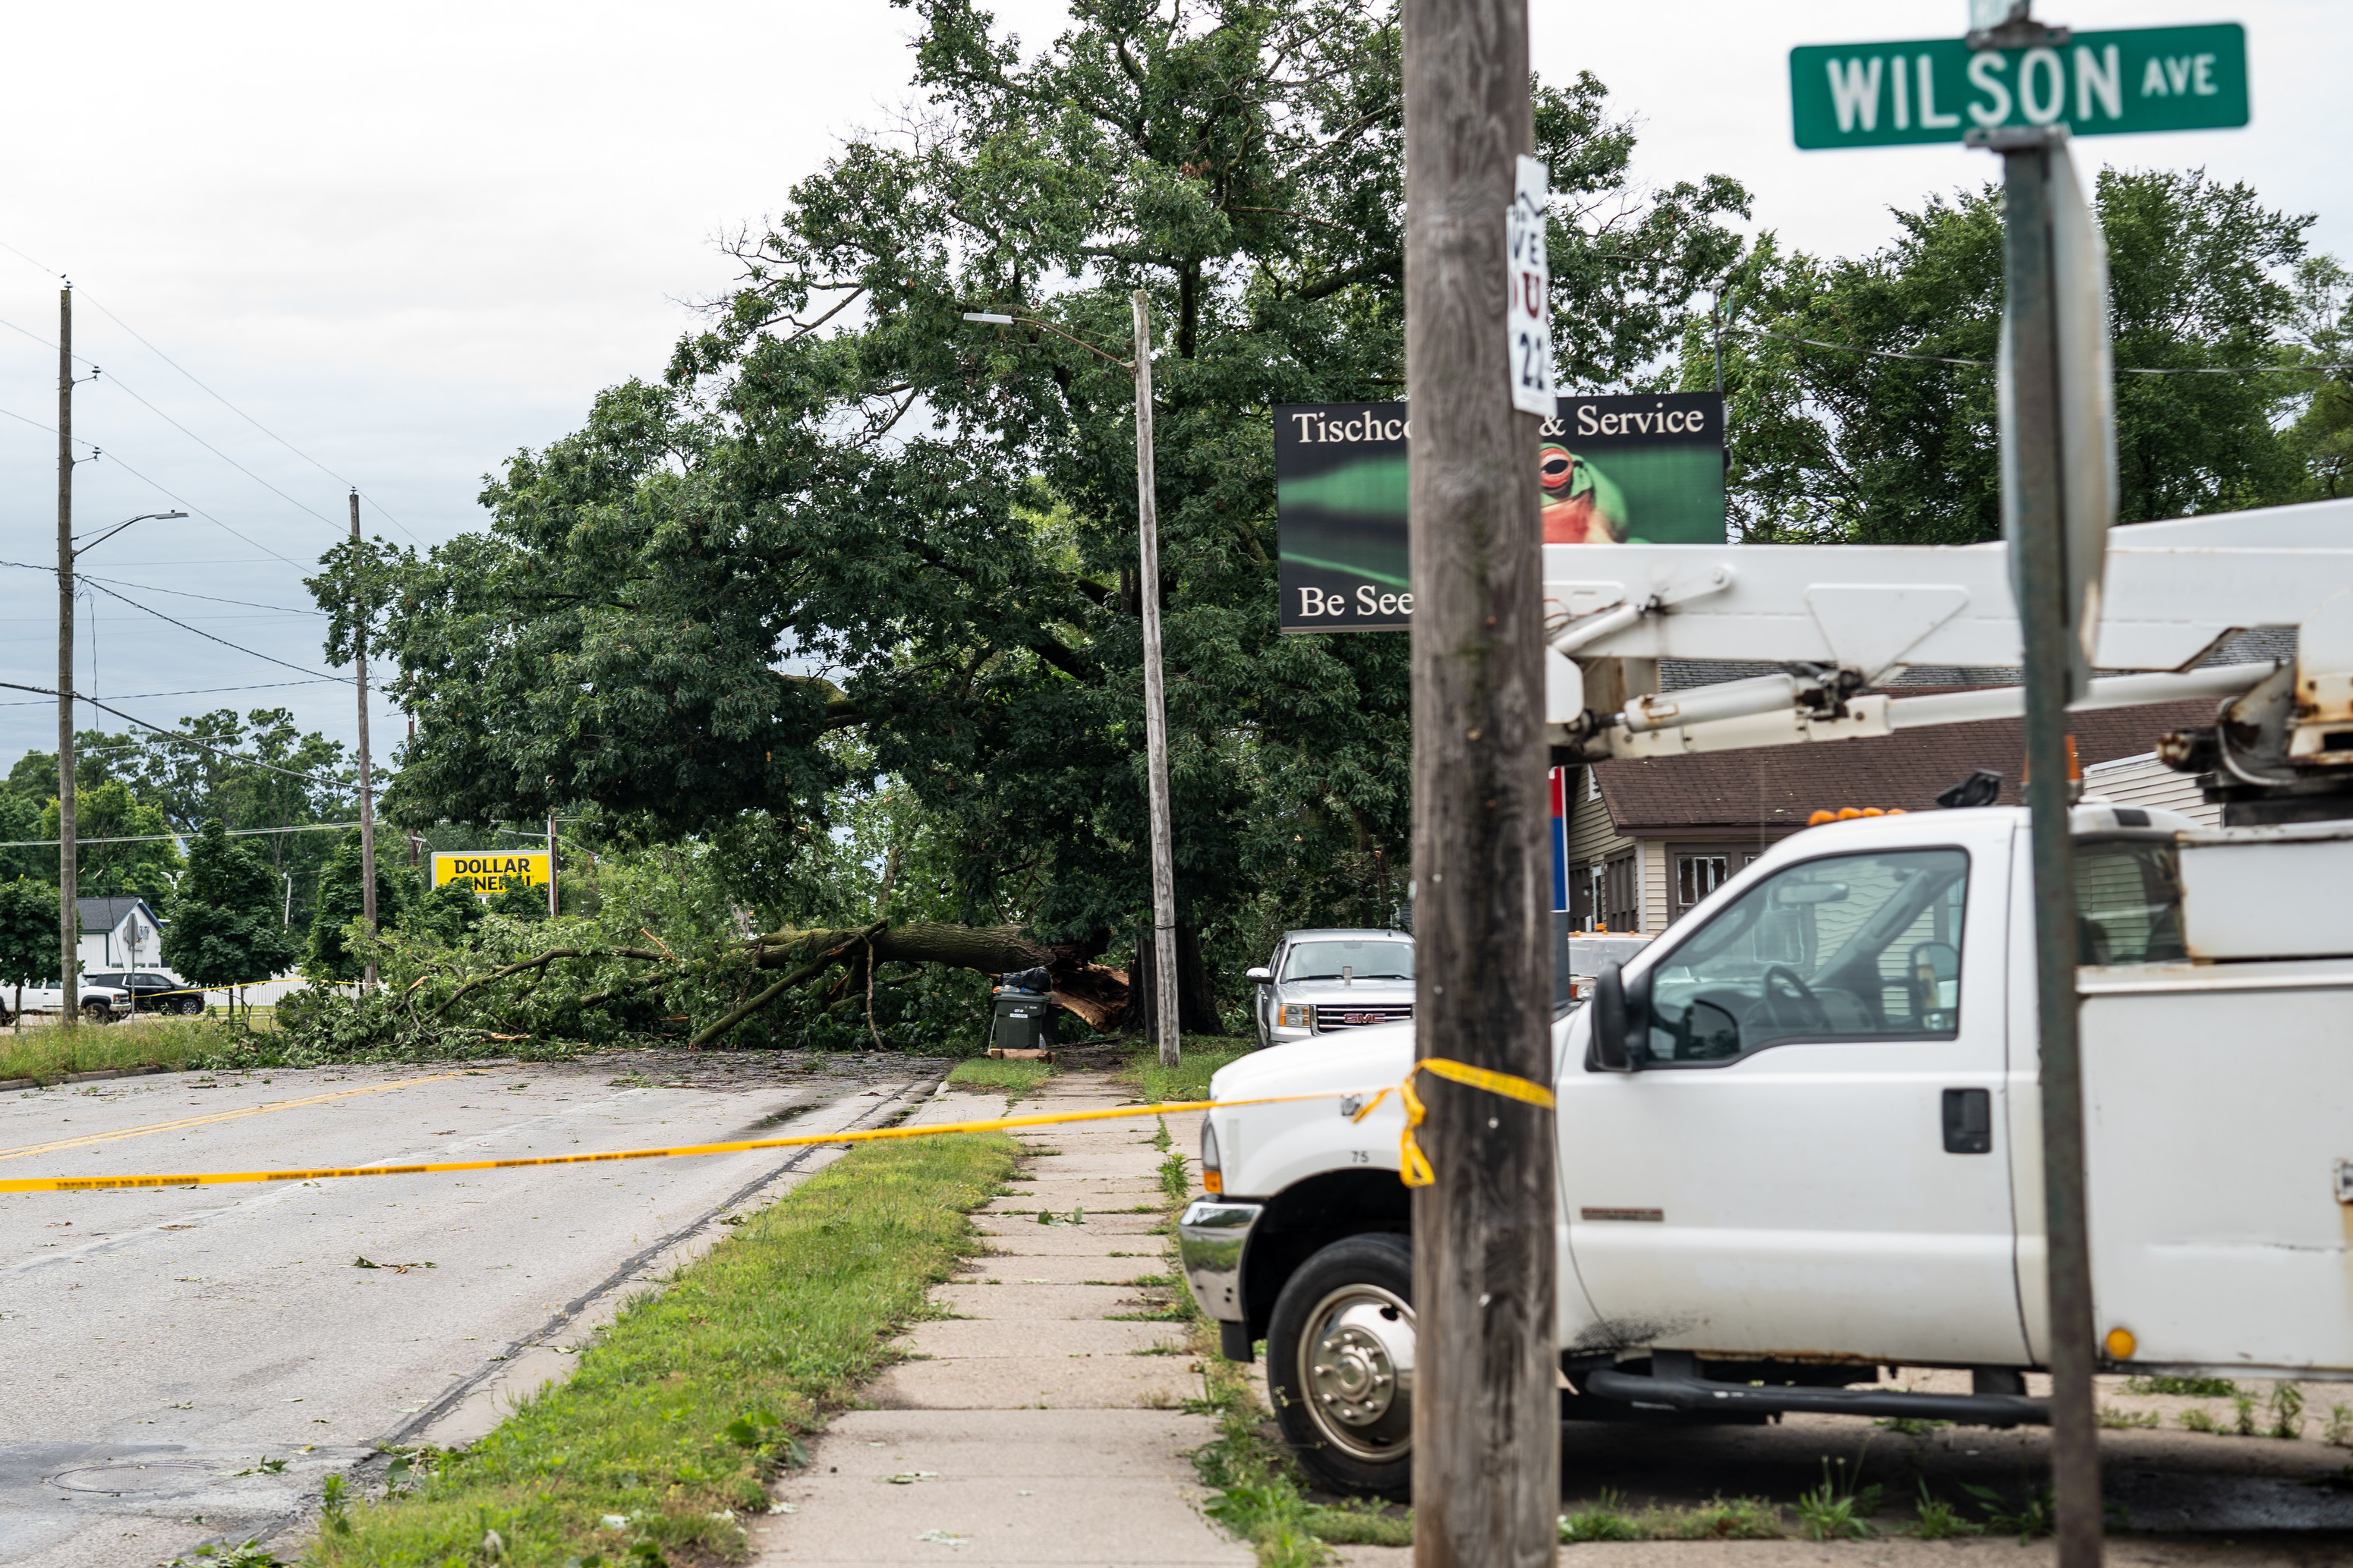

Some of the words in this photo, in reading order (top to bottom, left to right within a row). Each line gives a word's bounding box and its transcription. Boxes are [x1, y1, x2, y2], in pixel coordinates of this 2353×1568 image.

[1825, 44, 2123, 133] WILSON
[2141, 54, 2219, 97] AVE
[1539, 414, 1566, 436] &
[1577, 402, 1704, 436] Service
[1298, 587, 1345, 616] Be
[454, 858, 531, 874] DOLLAR
[1343, 1013, 1385, 1023] GMC
